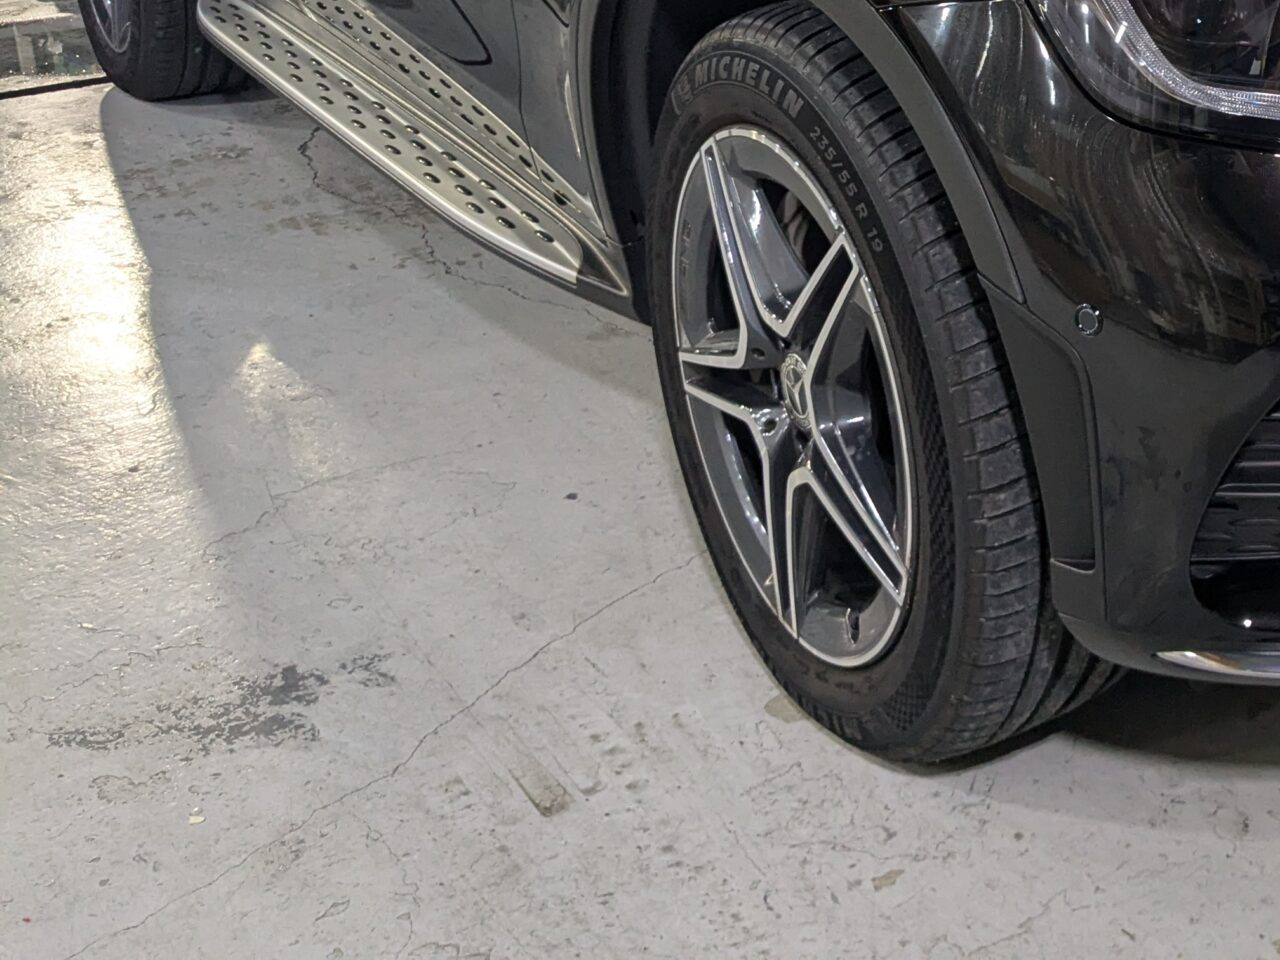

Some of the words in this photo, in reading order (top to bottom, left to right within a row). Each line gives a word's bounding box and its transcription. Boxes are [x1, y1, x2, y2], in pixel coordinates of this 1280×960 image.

[694, 54, 805, 119] MICHELIN
[809, 126, 859, 197] 235/55
[855, 203, 869, 220] R
[866, 227, 882, 253] 19
